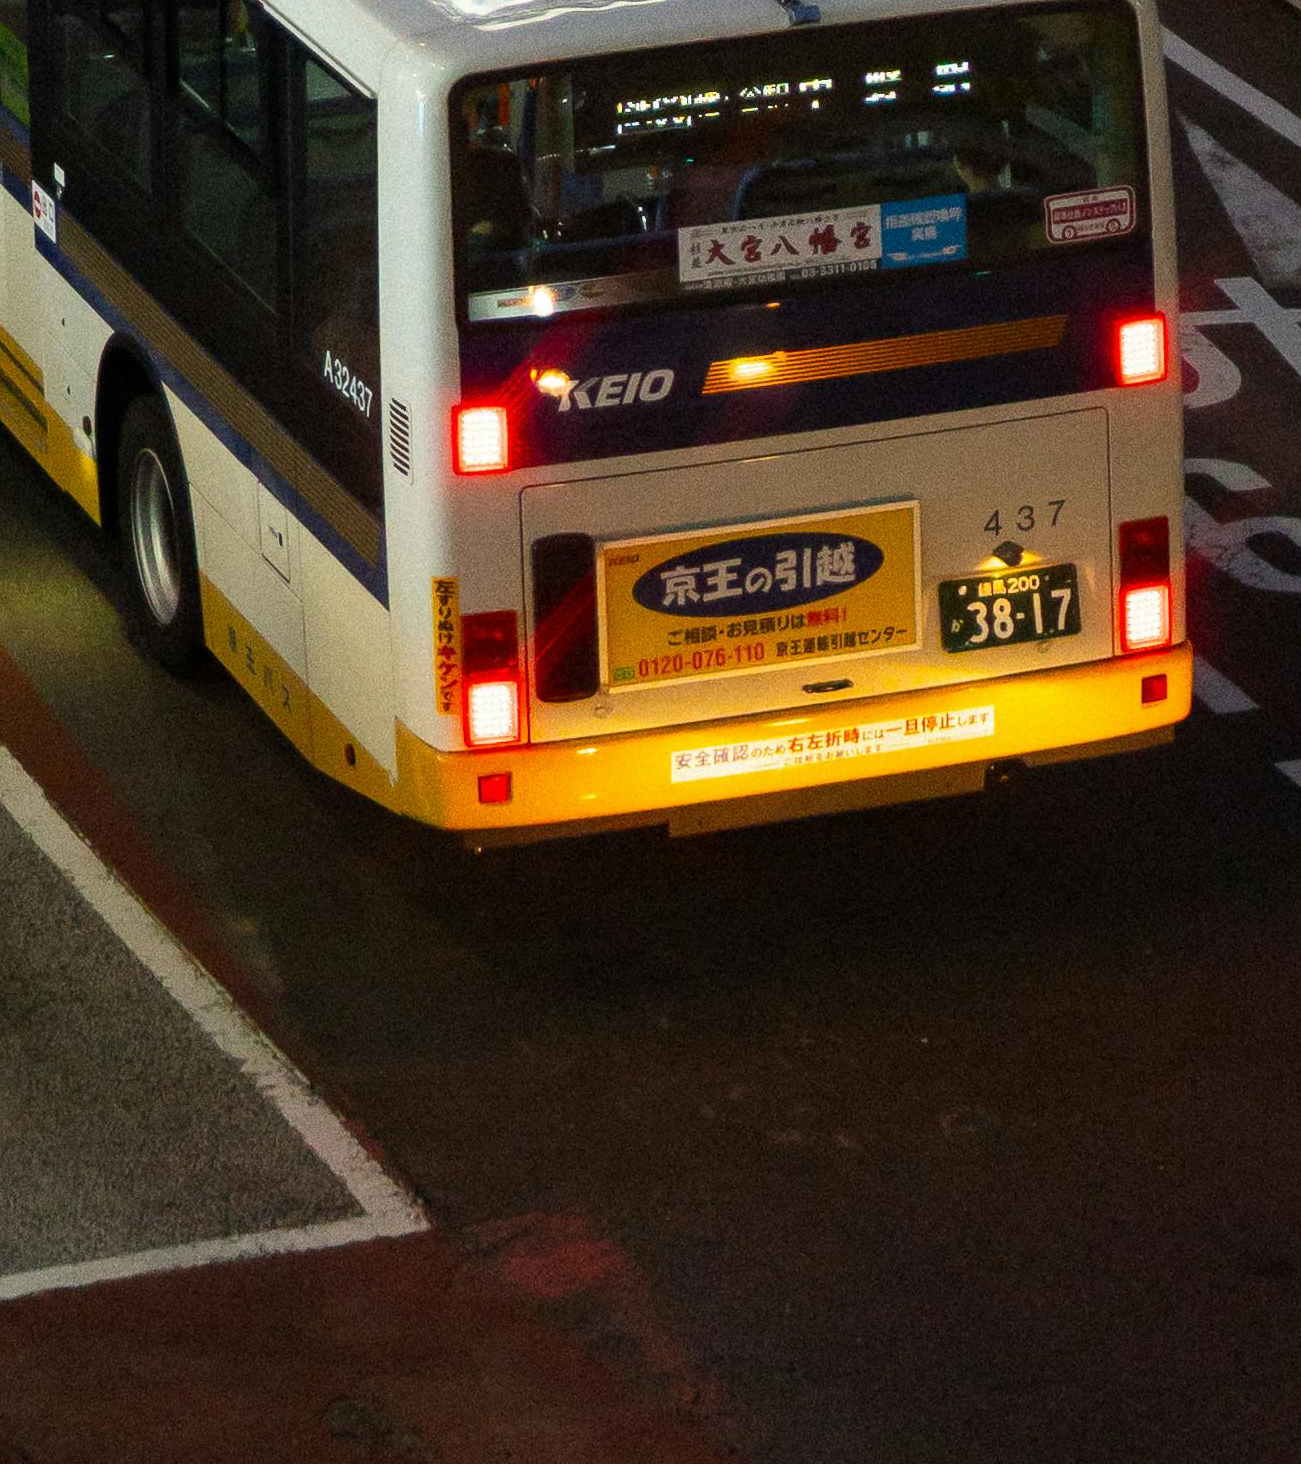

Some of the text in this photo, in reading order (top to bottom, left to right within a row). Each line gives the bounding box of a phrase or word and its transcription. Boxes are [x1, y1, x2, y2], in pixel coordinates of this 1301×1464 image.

[705, 221, 873, 267] 大宮八幡宮
[321, 349, 375, 419] A32437
[558, 367, 676, 413] KEIO
[659, 541, 856, 607] 京王の引越
[966, 588, 1072, 643] 38-17
[638, 626, 908, 679] 0120-076-110 京王運輸引越センター
